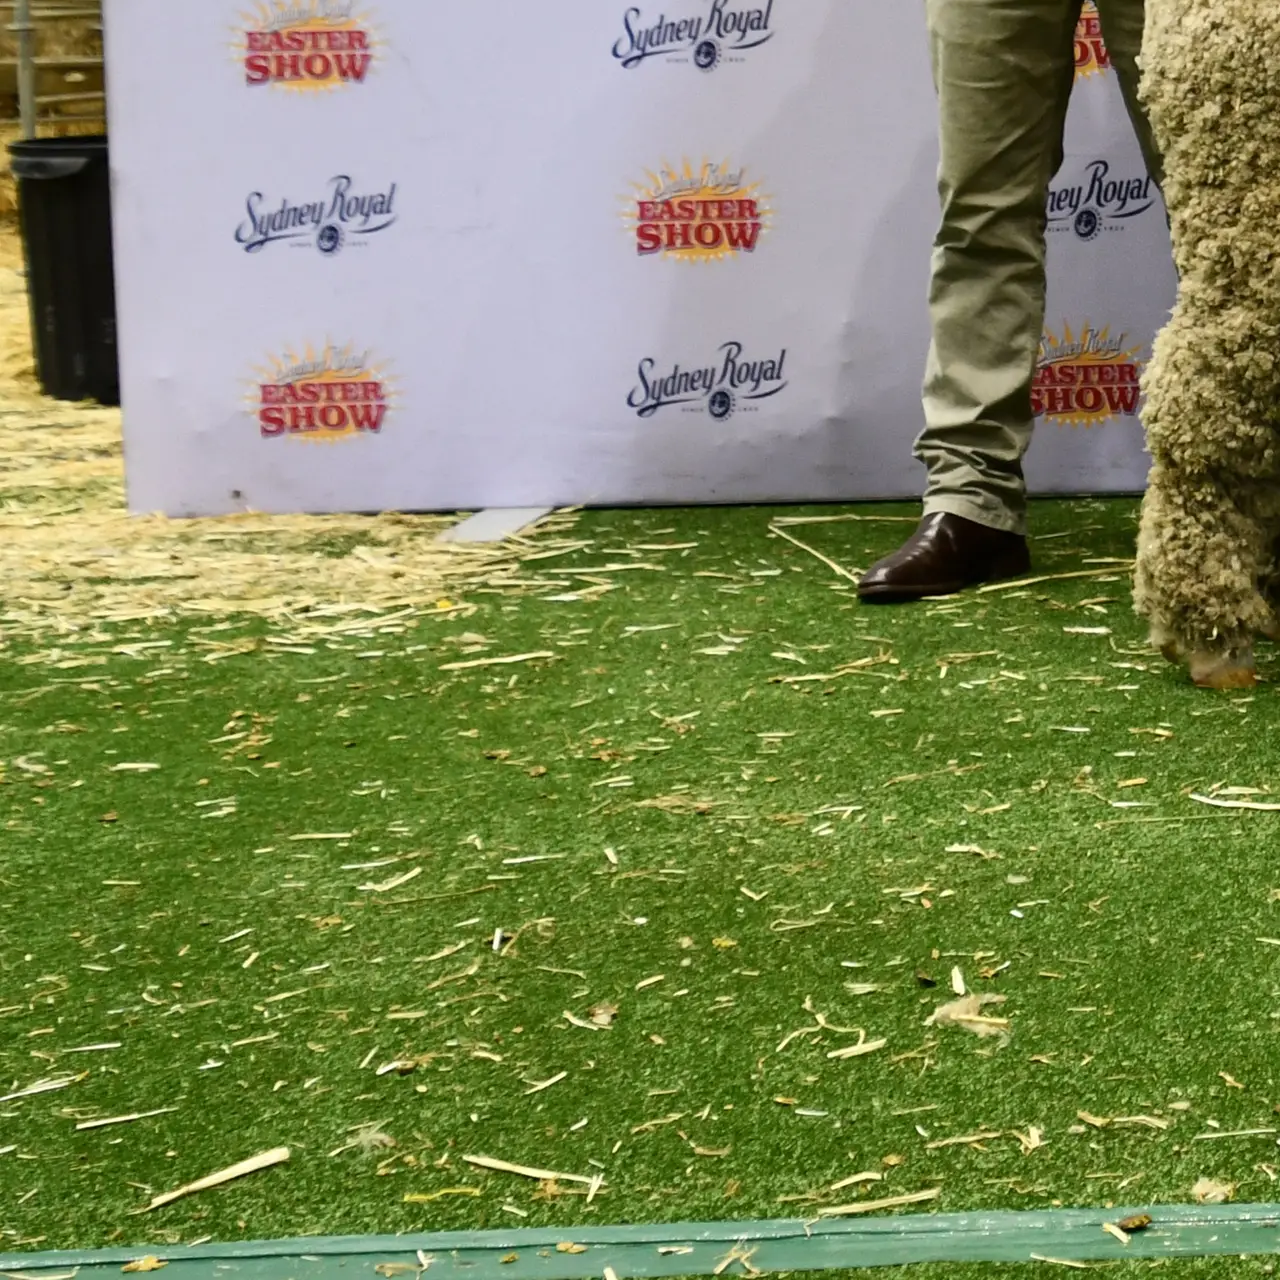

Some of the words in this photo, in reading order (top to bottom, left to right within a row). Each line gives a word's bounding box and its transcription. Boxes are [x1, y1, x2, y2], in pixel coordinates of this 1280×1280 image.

[245, 31, 369, 52] EASTER
[613, 8, 702, 69] Sydney
[245, 54, 372, 85] SHOW
[1084, 160, 1152, 214] Royal
[235, 192, 324, 253] Sydney
[328, 176, 396, 229] Royal
[637, 199, 761, 221] EASTER
[636, 222, 763, 254] SHOW
[260, 382, 385, 404] EASTER
[627, 358, 716, 417] Sydney
[718, 341, 788, 395] Royal
[260, 406, 387, 437] SHOW
